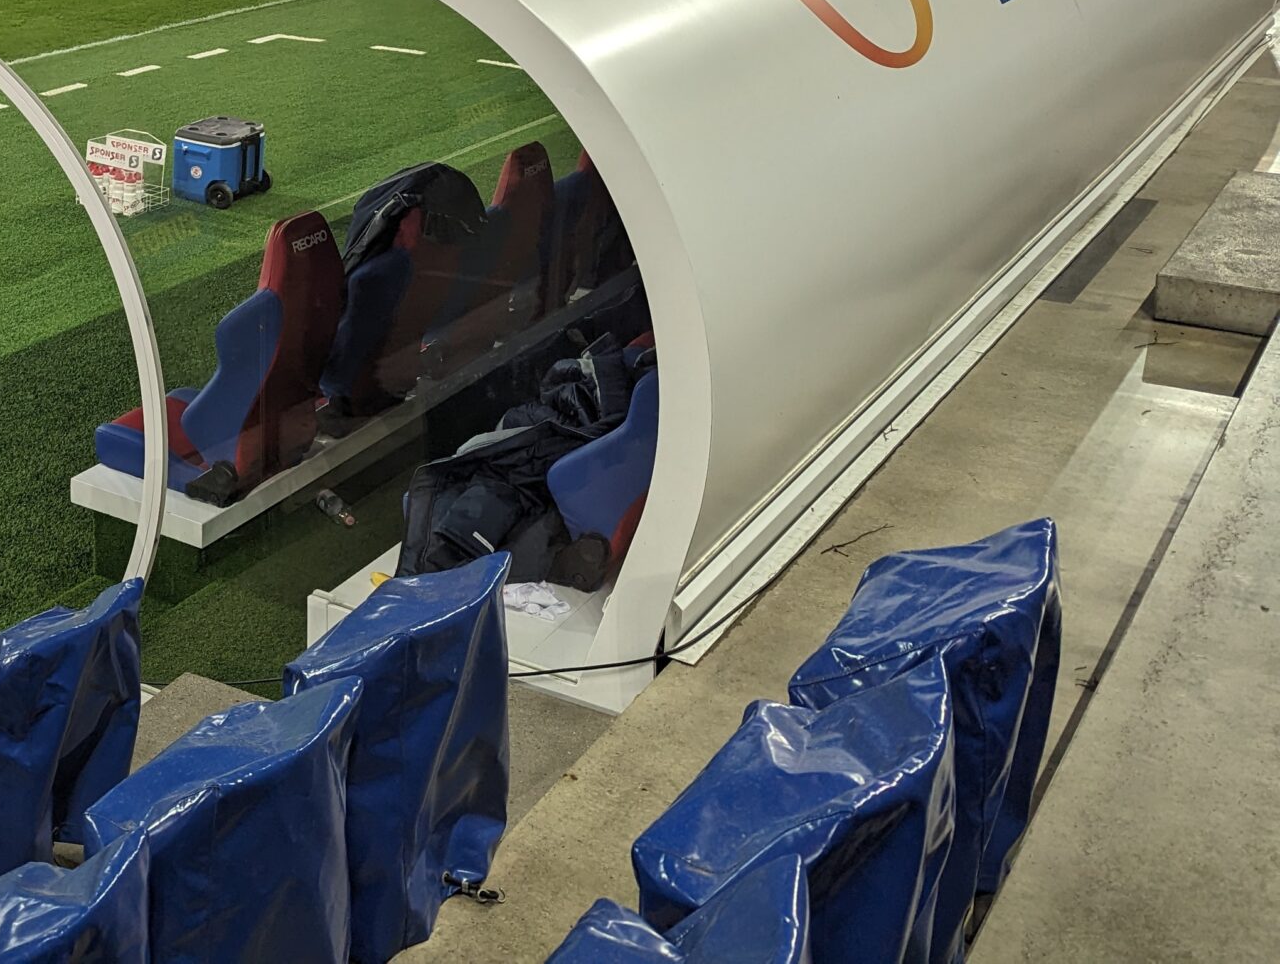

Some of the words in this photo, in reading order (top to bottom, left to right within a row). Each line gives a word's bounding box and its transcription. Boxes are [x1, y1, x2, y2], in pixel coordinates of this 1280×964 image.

[89, 145, 126, 162] SPONSER
[110, 140, 149, 155] SPONSER
[292, 229, 329, 254] RECARO
